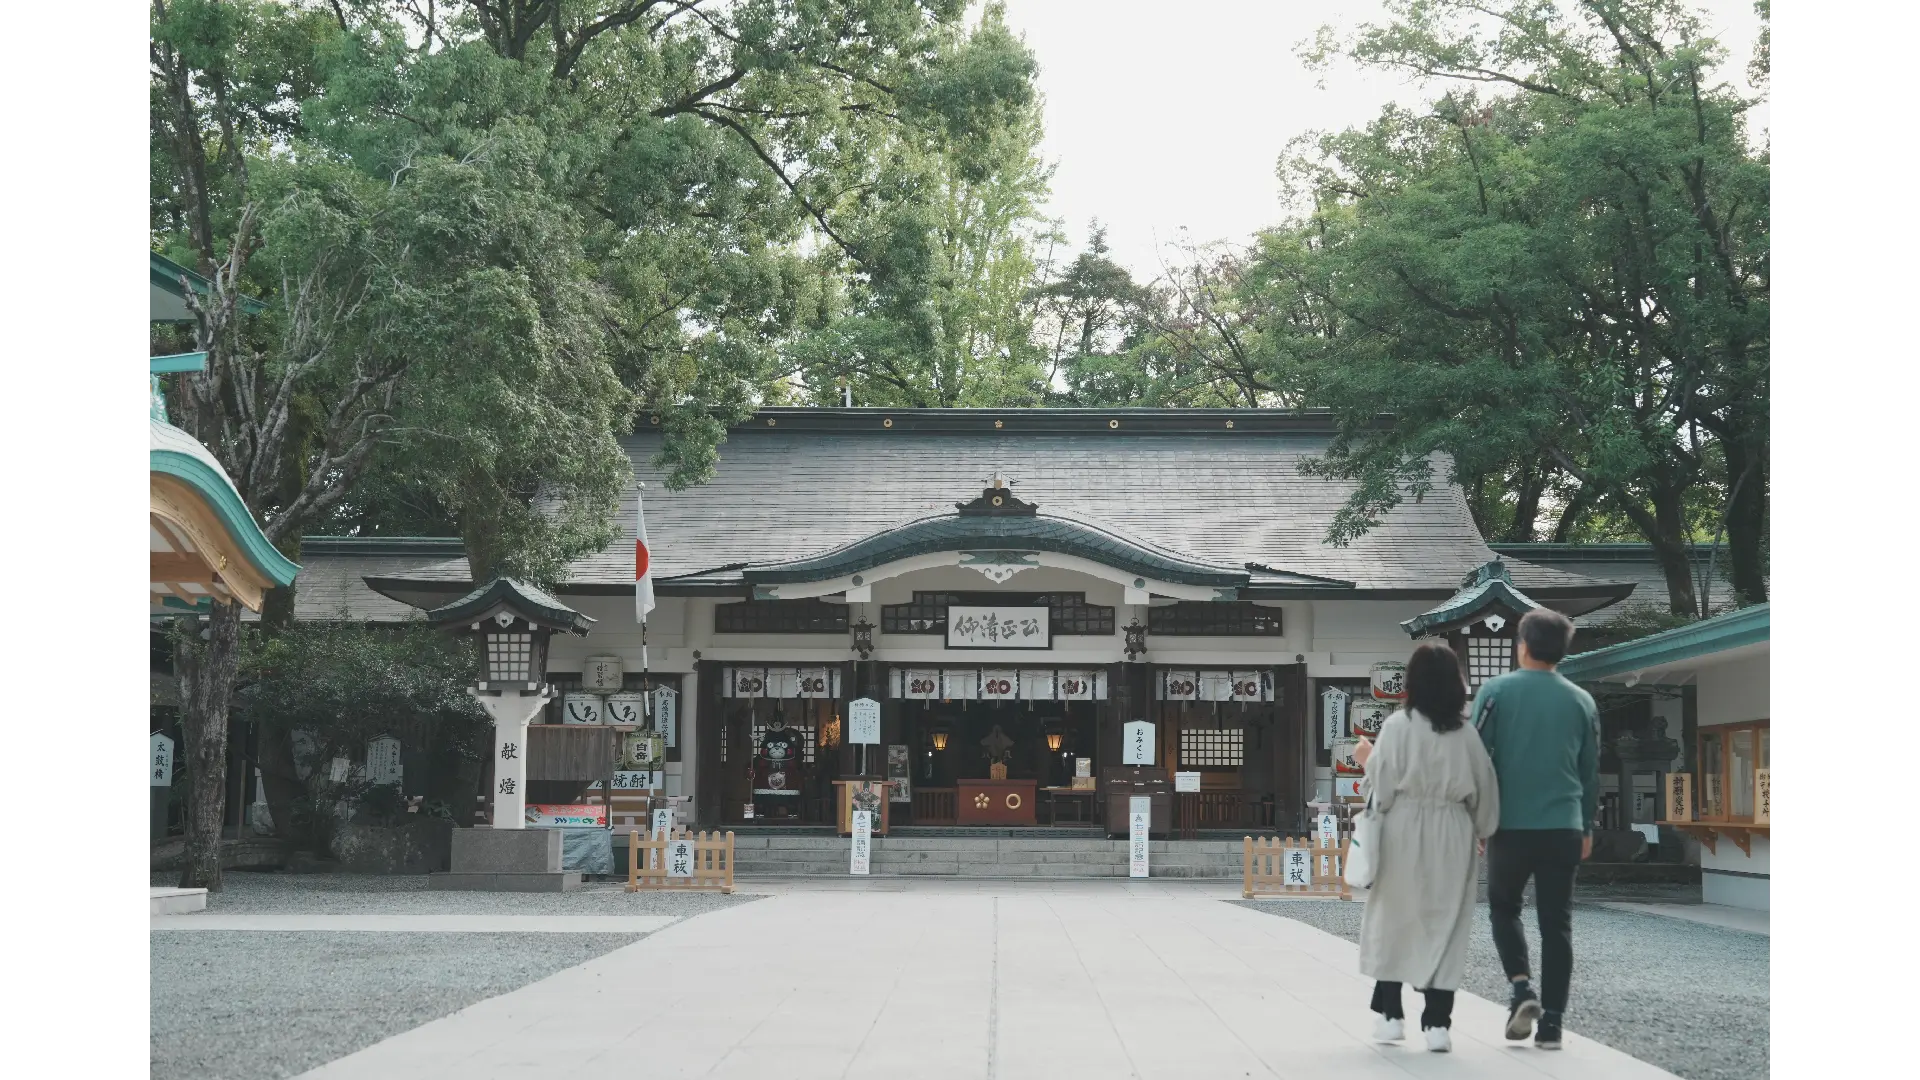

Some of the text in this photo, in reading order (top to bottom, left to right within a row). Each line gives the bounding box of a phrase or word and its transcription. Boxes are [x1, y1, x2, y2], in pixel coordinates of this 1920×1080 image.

[568, 702, 598, 722] しろ
[608, 702, 637, 722] しろ
[635, 742, 648, 761] 白岳
[1135, 728, 1144, 760] おみくじ
[499, 742, 518, 795] 献燈
[1673, 776, 1685, 816] 祈願受付
